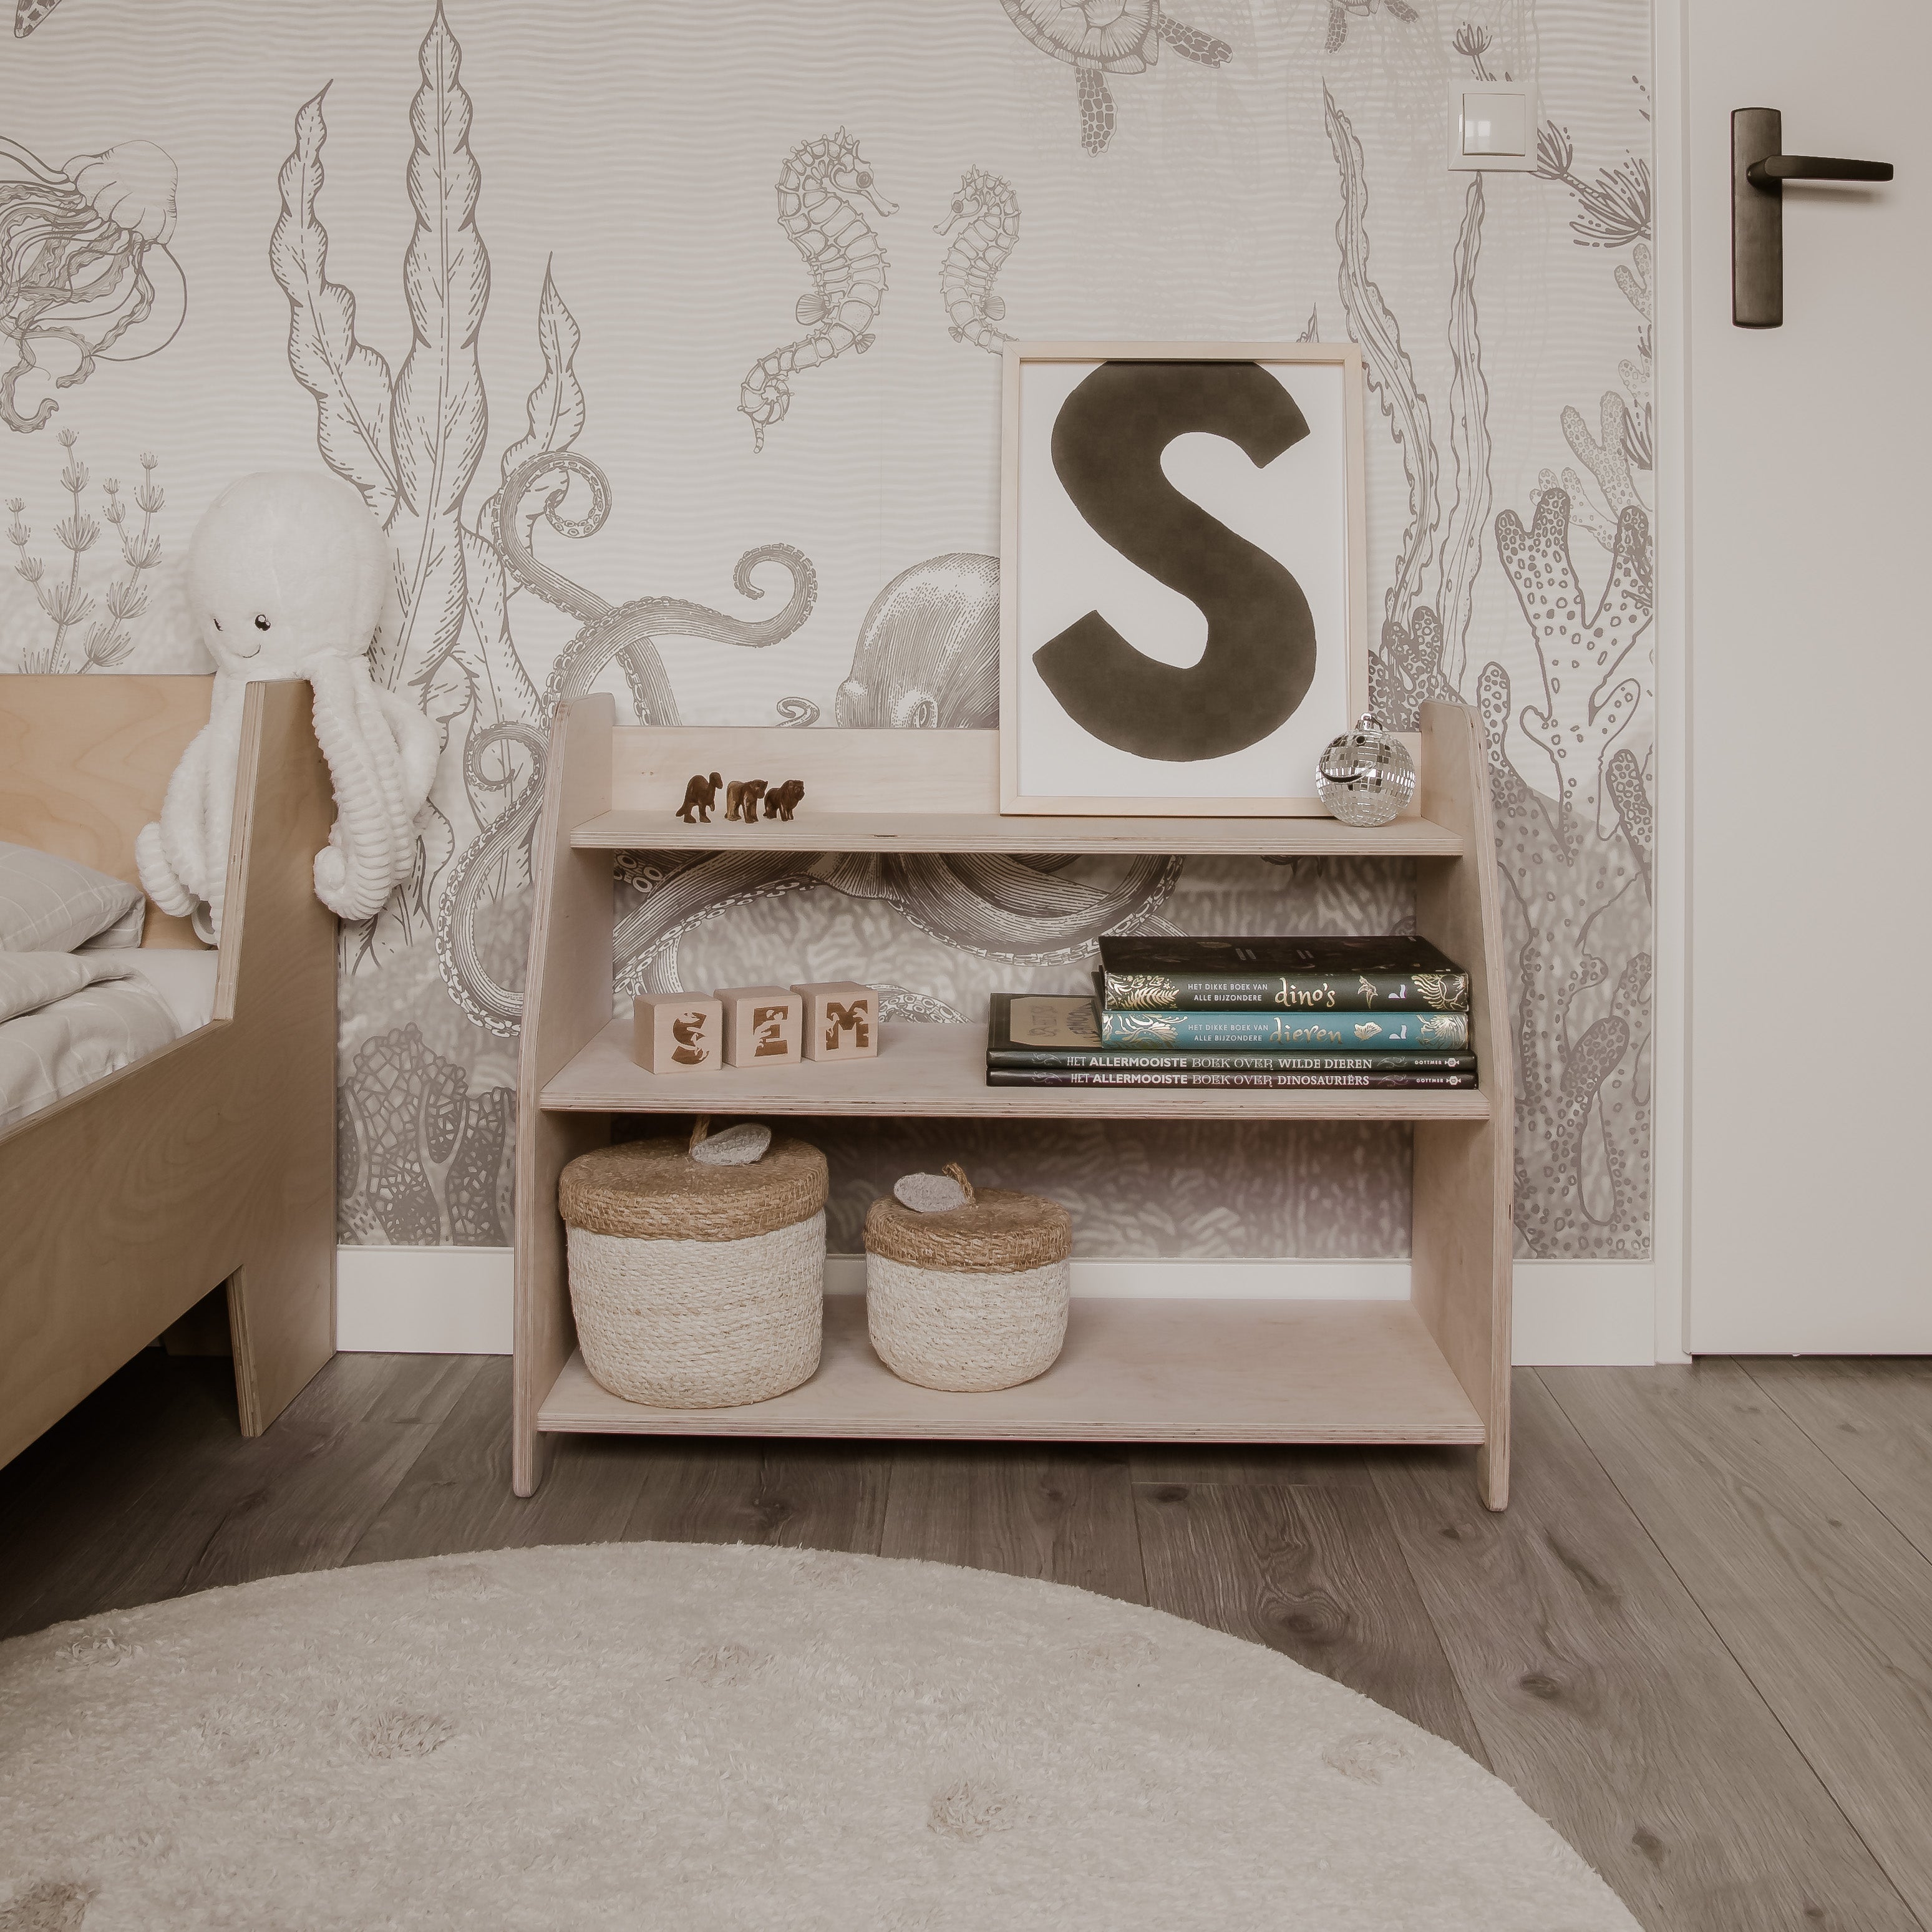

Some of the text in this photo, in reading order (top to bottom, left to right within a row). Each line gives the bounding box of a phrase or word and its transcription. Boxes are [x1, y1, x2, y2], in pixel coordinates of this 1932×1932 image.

[1032, 360, 1317, 762] S
[1274, 977, 1336, 1007] dino's
[1268, 1017, 1342, 1045] dieren
[1067, 1056, 1372, 1070] HET ALLERMOOISTE BOEK OVER WILDE DIEREN
[1070, 1073, 1370, 1087] HET ALLERMOOISTE BOEK OVER DINOSAURIËRS
